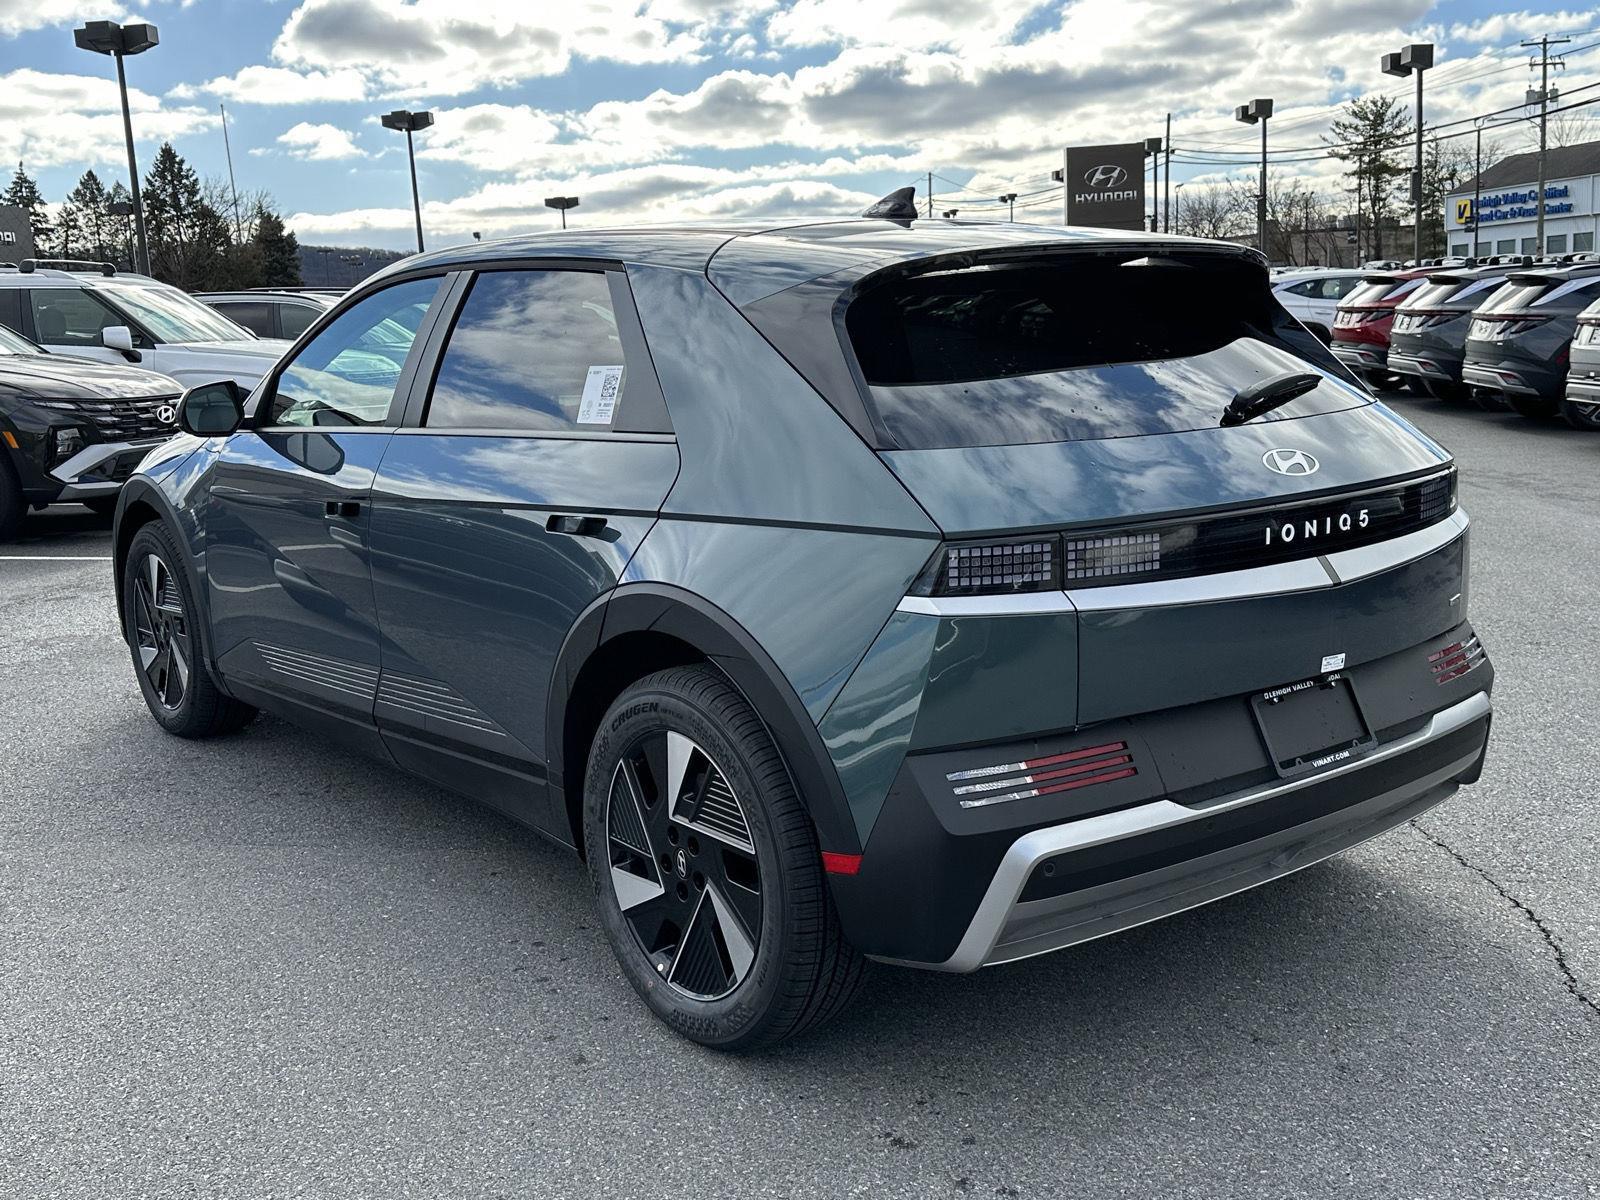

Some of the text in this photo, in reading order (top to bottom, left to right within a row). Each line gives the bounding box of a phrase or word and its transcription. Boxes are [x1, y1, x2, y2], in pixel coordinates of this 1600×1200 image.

[1075, 190, 1137, 204] HYUNDAI
[1502, 191, 1527, 204] Valley
[1494, 209, 1509, 220] Car
[1269, 686, 1292, 698] LEHIGH
[1292, 680, 1314, 691] VALLEY
[611, 702, 659, 732] CRUGEN
[1312, 750, 1350, 768] VINART.COM
